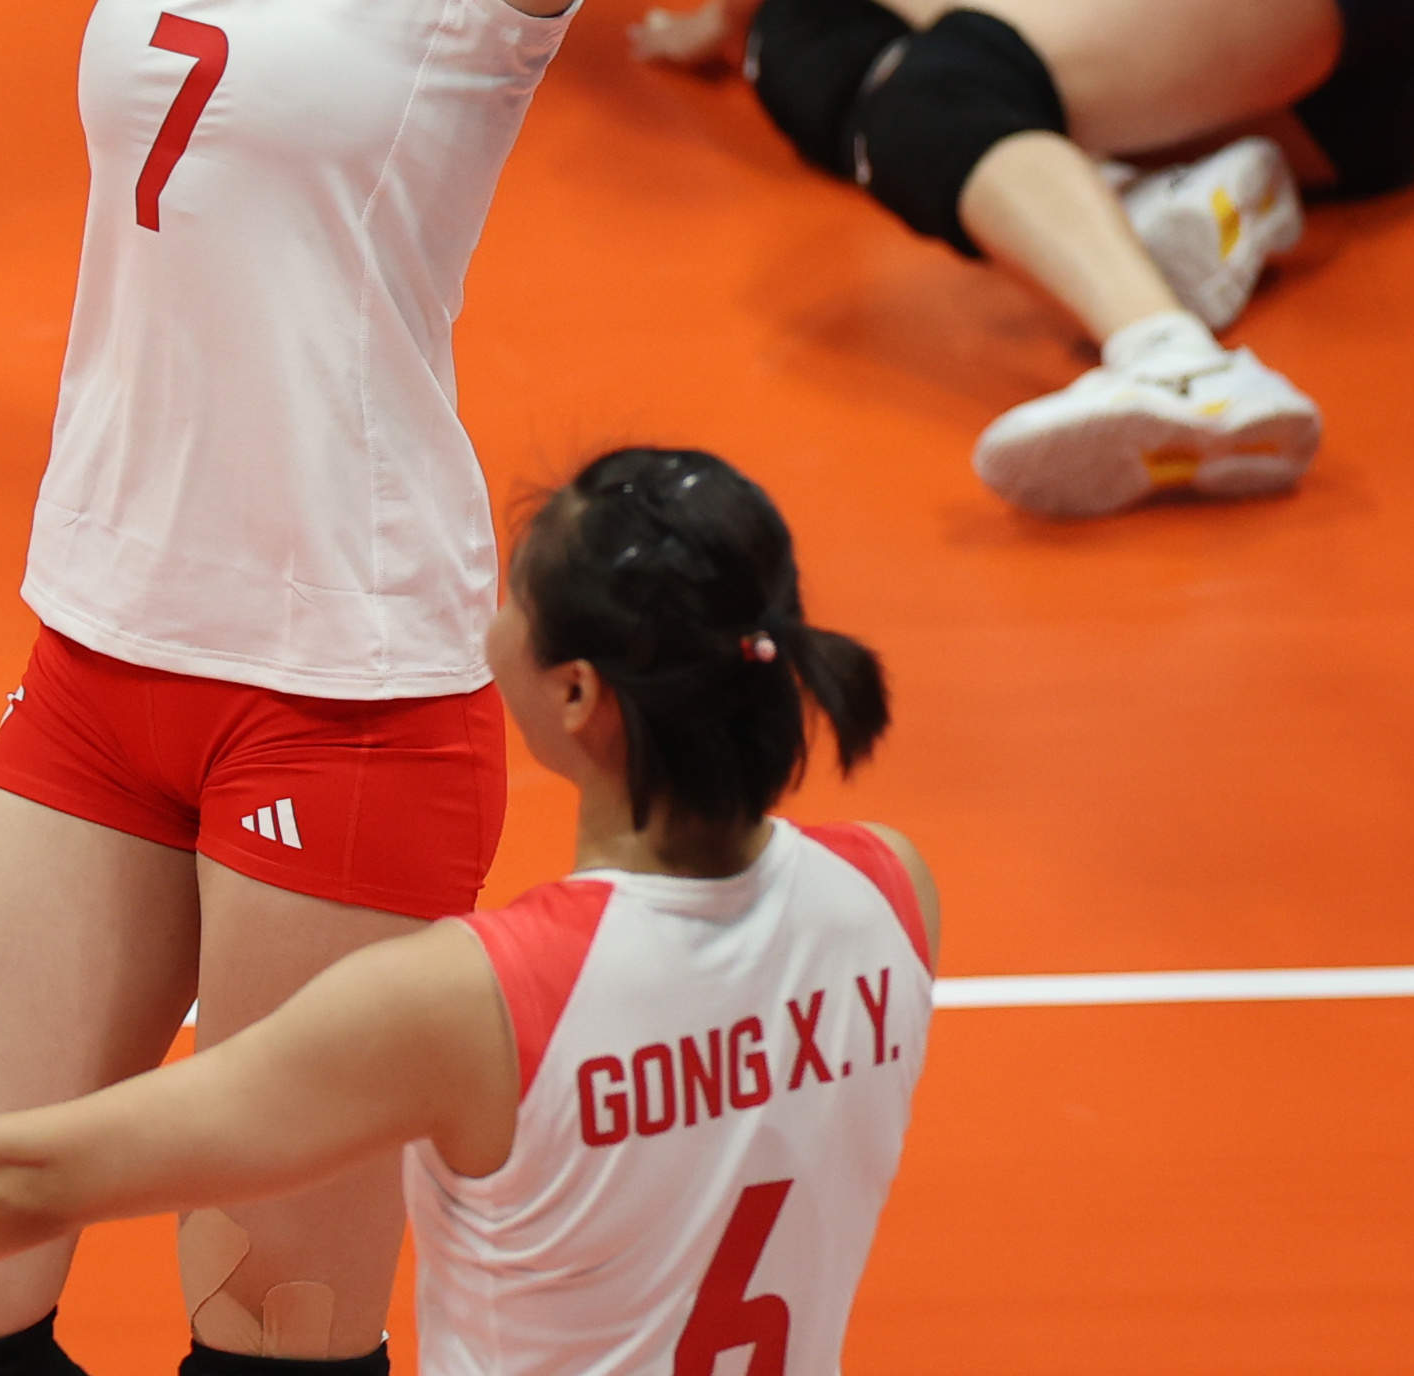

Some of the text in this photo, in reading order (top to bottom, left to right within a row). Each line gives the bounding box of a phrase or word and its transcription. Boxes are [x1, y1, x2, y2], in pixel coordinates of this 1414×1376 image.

[135, 11, 230, 233] 7
[577, 1015, 772, 1148] GONG
[672, 1177, 795, 1376] 6
